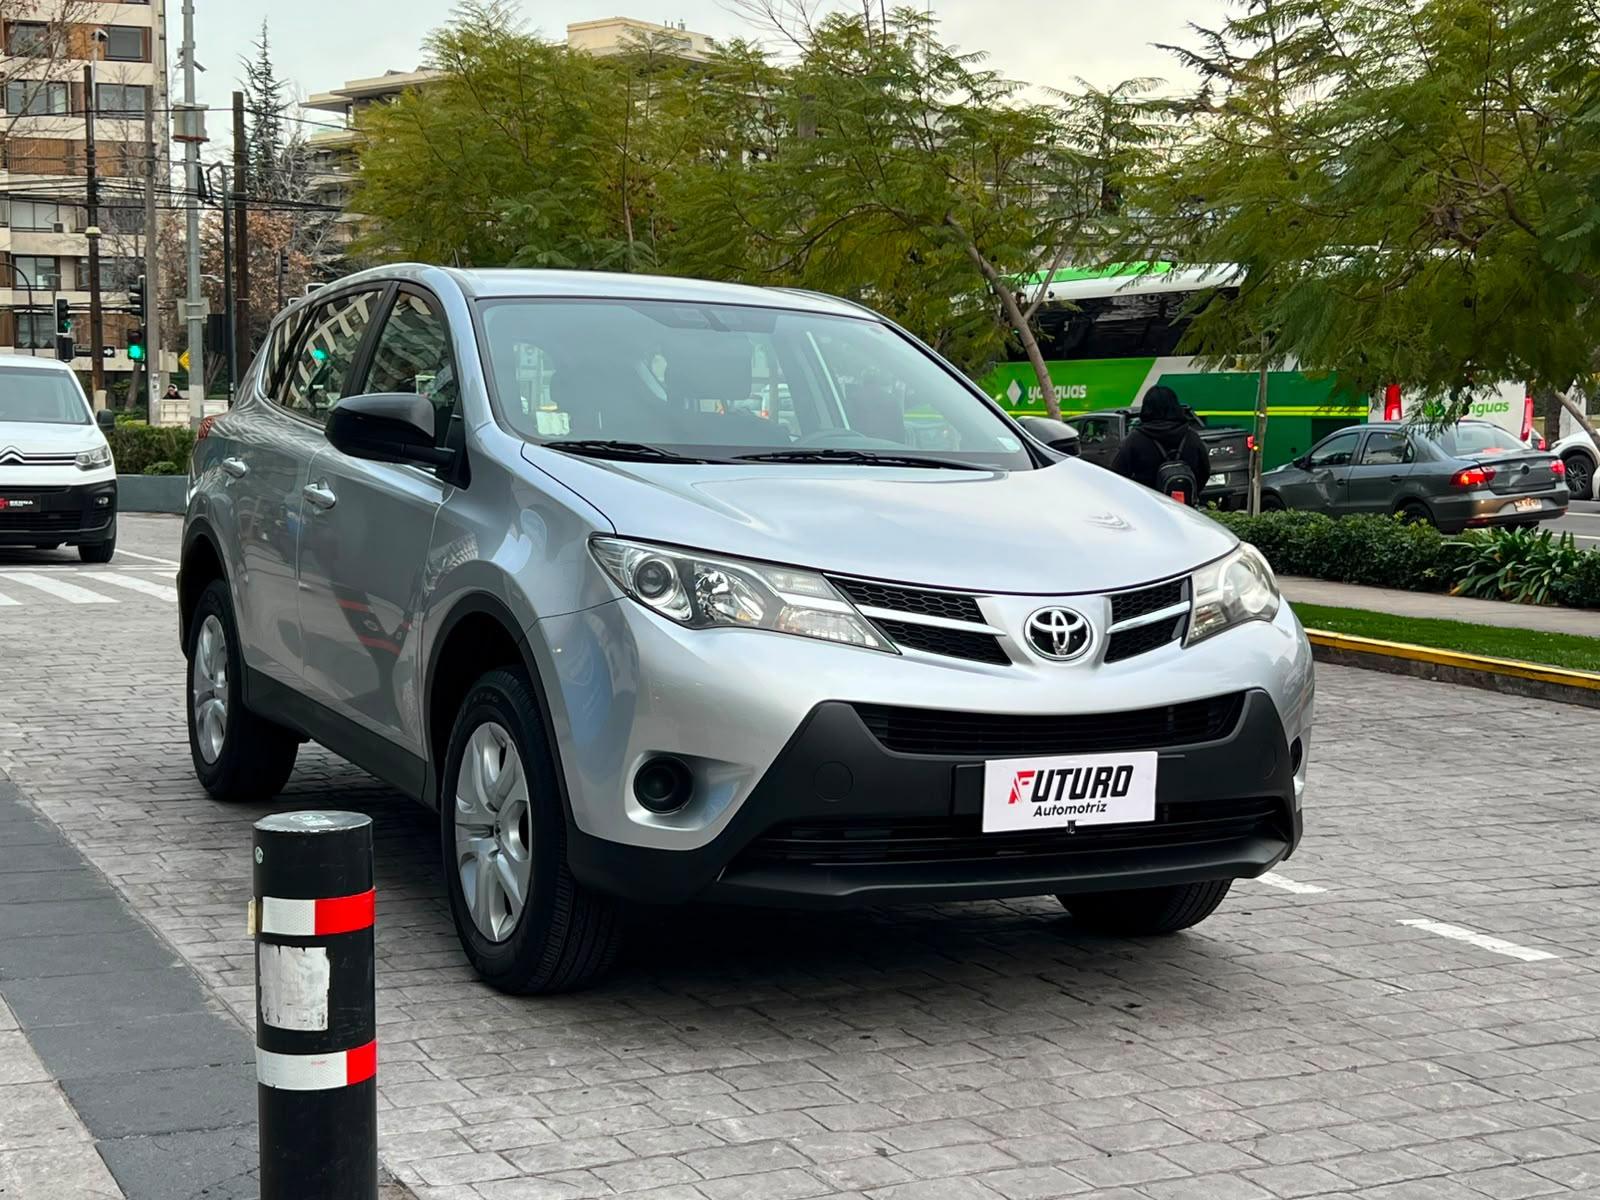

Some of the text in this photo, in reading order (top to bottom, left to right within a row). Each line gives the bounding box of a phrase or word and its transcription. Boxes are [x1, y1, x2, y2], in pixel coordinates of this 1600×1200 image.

[1027, 384, 1087, 405] yaguas
[1008, 765, 1134, 804] FUTURO
[1033, 800, 1107, 817] Automotriz
